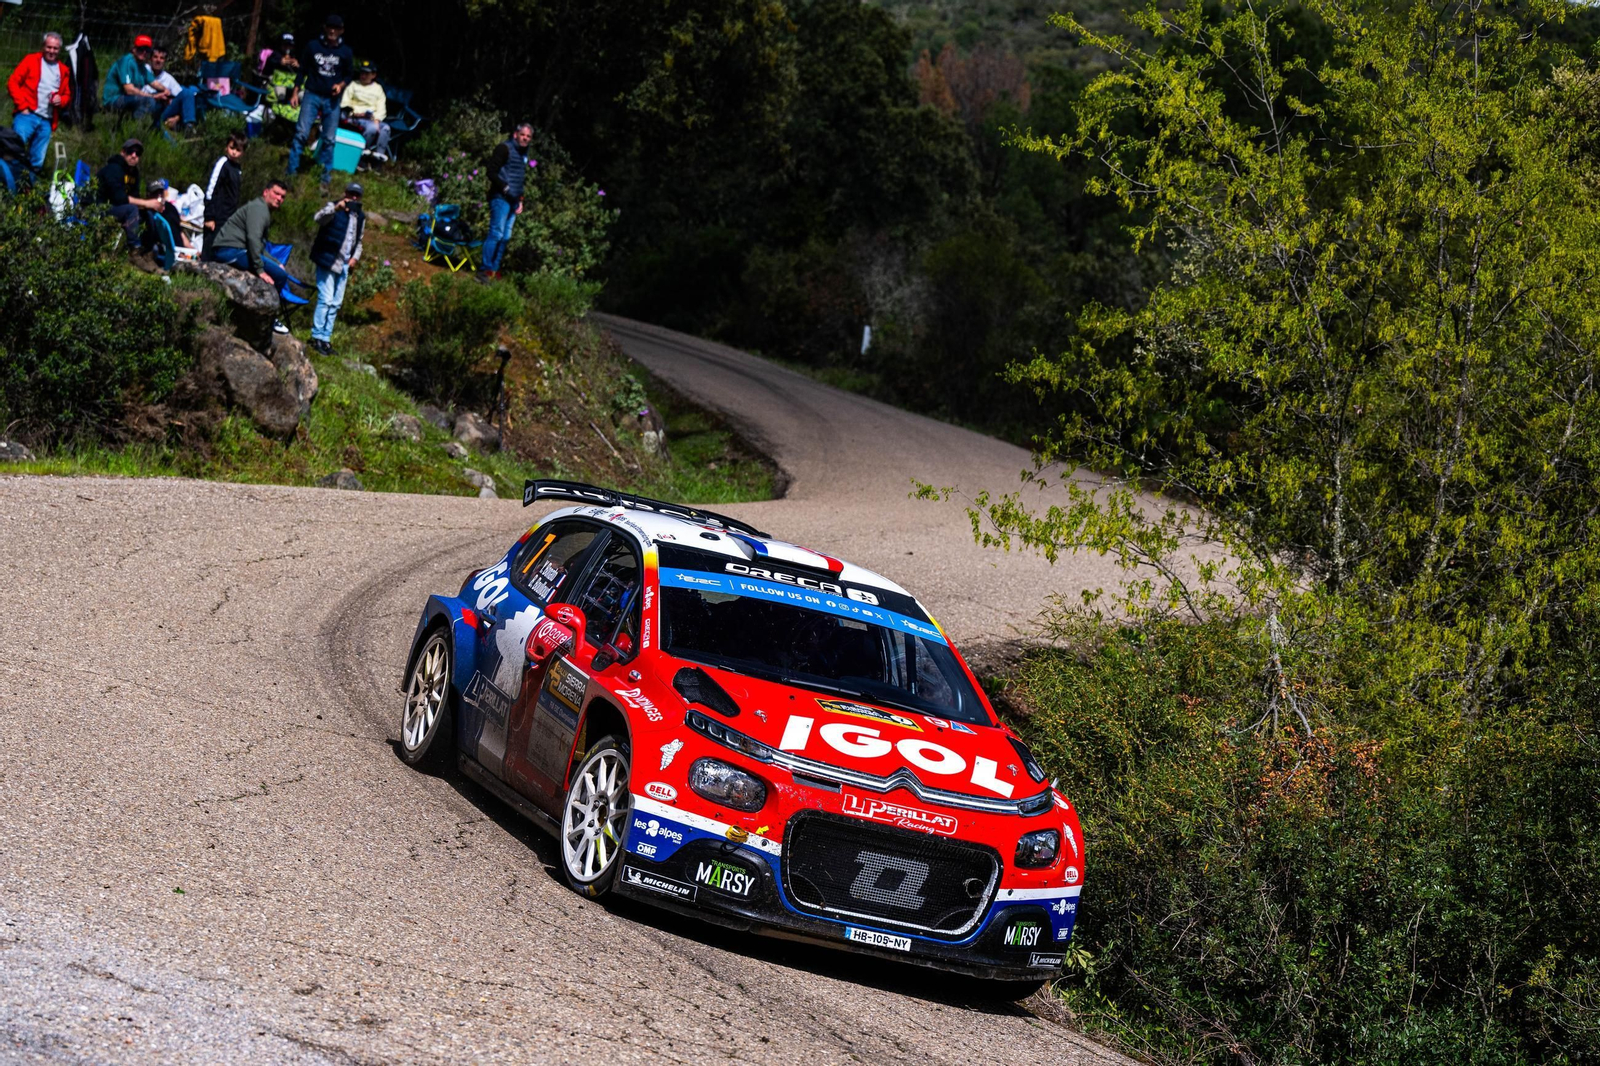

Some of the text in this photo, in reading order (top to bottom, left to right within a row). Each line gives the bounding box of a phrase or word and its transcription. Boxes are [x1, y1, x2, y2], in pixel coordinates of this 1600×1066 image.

[522, 533, 557, 574] 1
[684, 575, 721, 587] ERC
[724, 562, 842, 594] ORECA
[740, 583, 785, 597] FOLLOW
[787, 591, 802, 601] US
[805, 595, 820, 605] ON
[556, 682, 582, 707] MORENA
[565, 673, 586, 696] SIERRA
[779, 715, 1014, 798] IGOL
[649, 784, 672, 797] BELL
[634, 818, 683, 841] les 2 alpes
[893, 816, 935, 834] Racing
[637, 843, 657, 856] OMP
[711, 859, 747, 875] TRANSPORTS
[643, 877, 690, 895] MICHELIN
[695, 862, 756, 896] MARSY
[853, 930, 908, 948] HB-105-NY
[1003, 925, 1042, 946] MARSY
